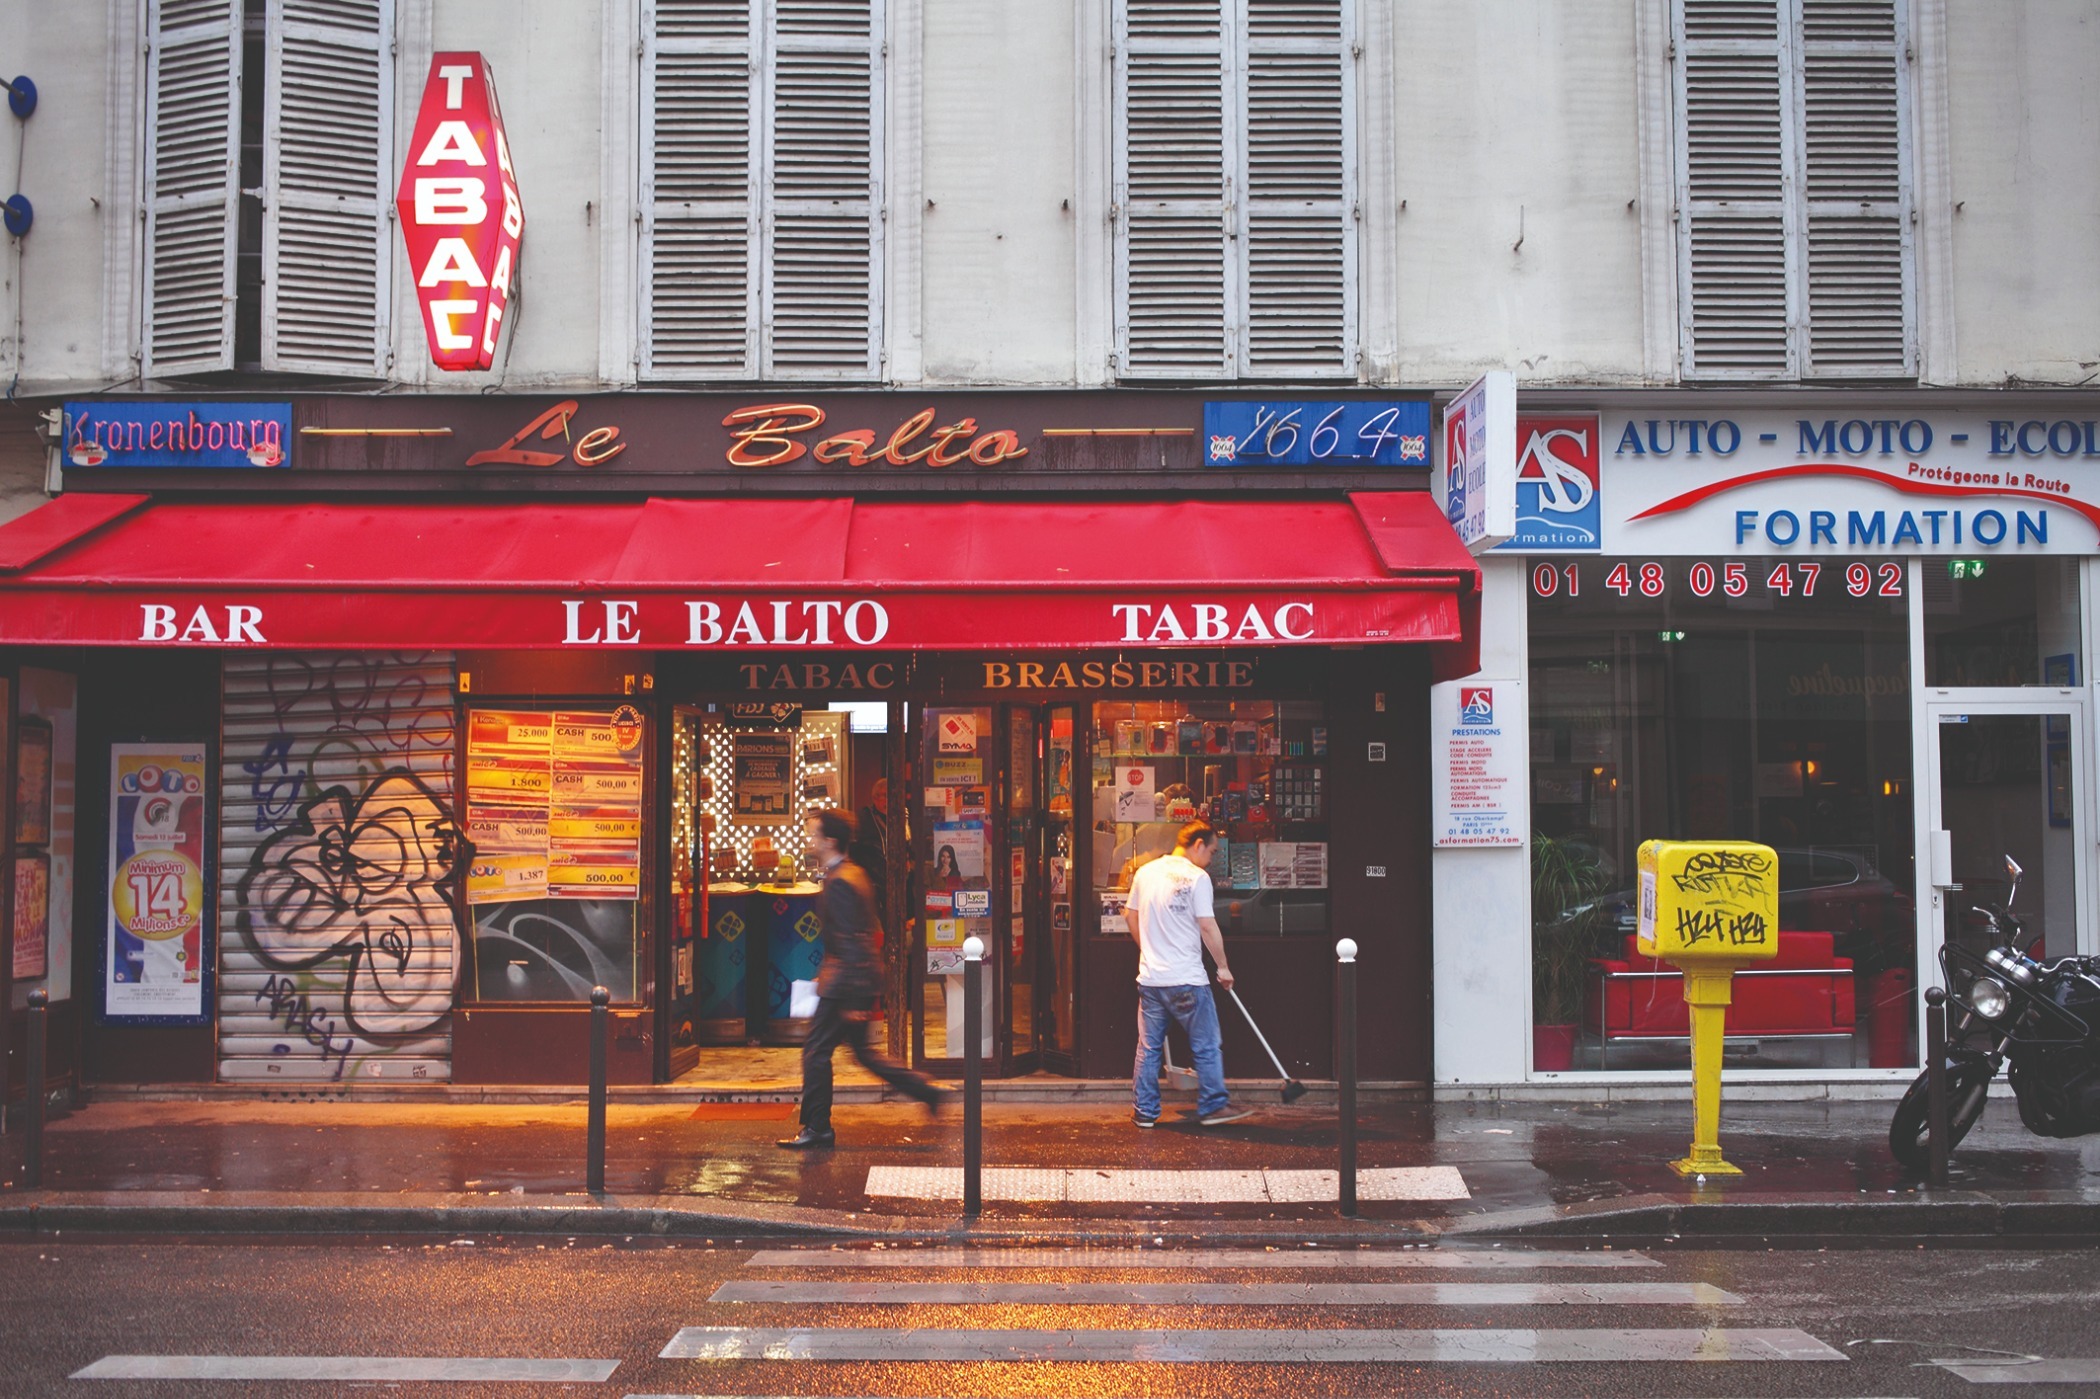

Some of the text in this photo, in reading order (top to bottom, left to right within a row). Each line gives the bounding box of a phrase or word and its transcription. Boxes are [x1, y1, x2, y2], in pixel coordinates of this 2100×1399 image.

[414, 65, 488, 349] TABAC
[64, 410, 281, 463] Kronenbourg
[466, 400, 1028, 468] Le Balto
[1237, 405, 1399, 459] 1664
[1615, 418, 1742, 456] AUTO
[1796, 418, 1934, 456] MOTO
[1516, 428, 1594, 514] AS
[1907, 462, 2072, 494] Protégeons la Route
[1735, 509, 2049, 547] FORMATION
[1533, 562, 1902, 597] 01 48 05 47 92
[138, 604, 267, 643] BAR
[561, 599, 890, 646] LE BALTO
[1112, 602, 1316, 642] TABAC
[740, 663, 895, 690] TABAC
[982, 660, 1254, 689] BRASSERIE
[1464, 690, 1491, 715] AS
[557, 728, 584, 737] CASH
[1452, 728, 1501, 736] PRESTATIONS
[737, 745, 774, 753] PARIONS
[121, 765, 200, 793] LOTO
[511, 778, 541, 787] 1.800
[555, 775, 583, 784] CASH
[471, 823, 499, 832] CASH
[1439, 836, 1519, 844] asformation75.com
[129, 861, 185, 876] Minimum
[470, 864, 503, 878] LOTO
[129, 874, 186, 921] 14
[968, 893, 986, 901] Lyca
[130, 915, 176, 933] Millions
